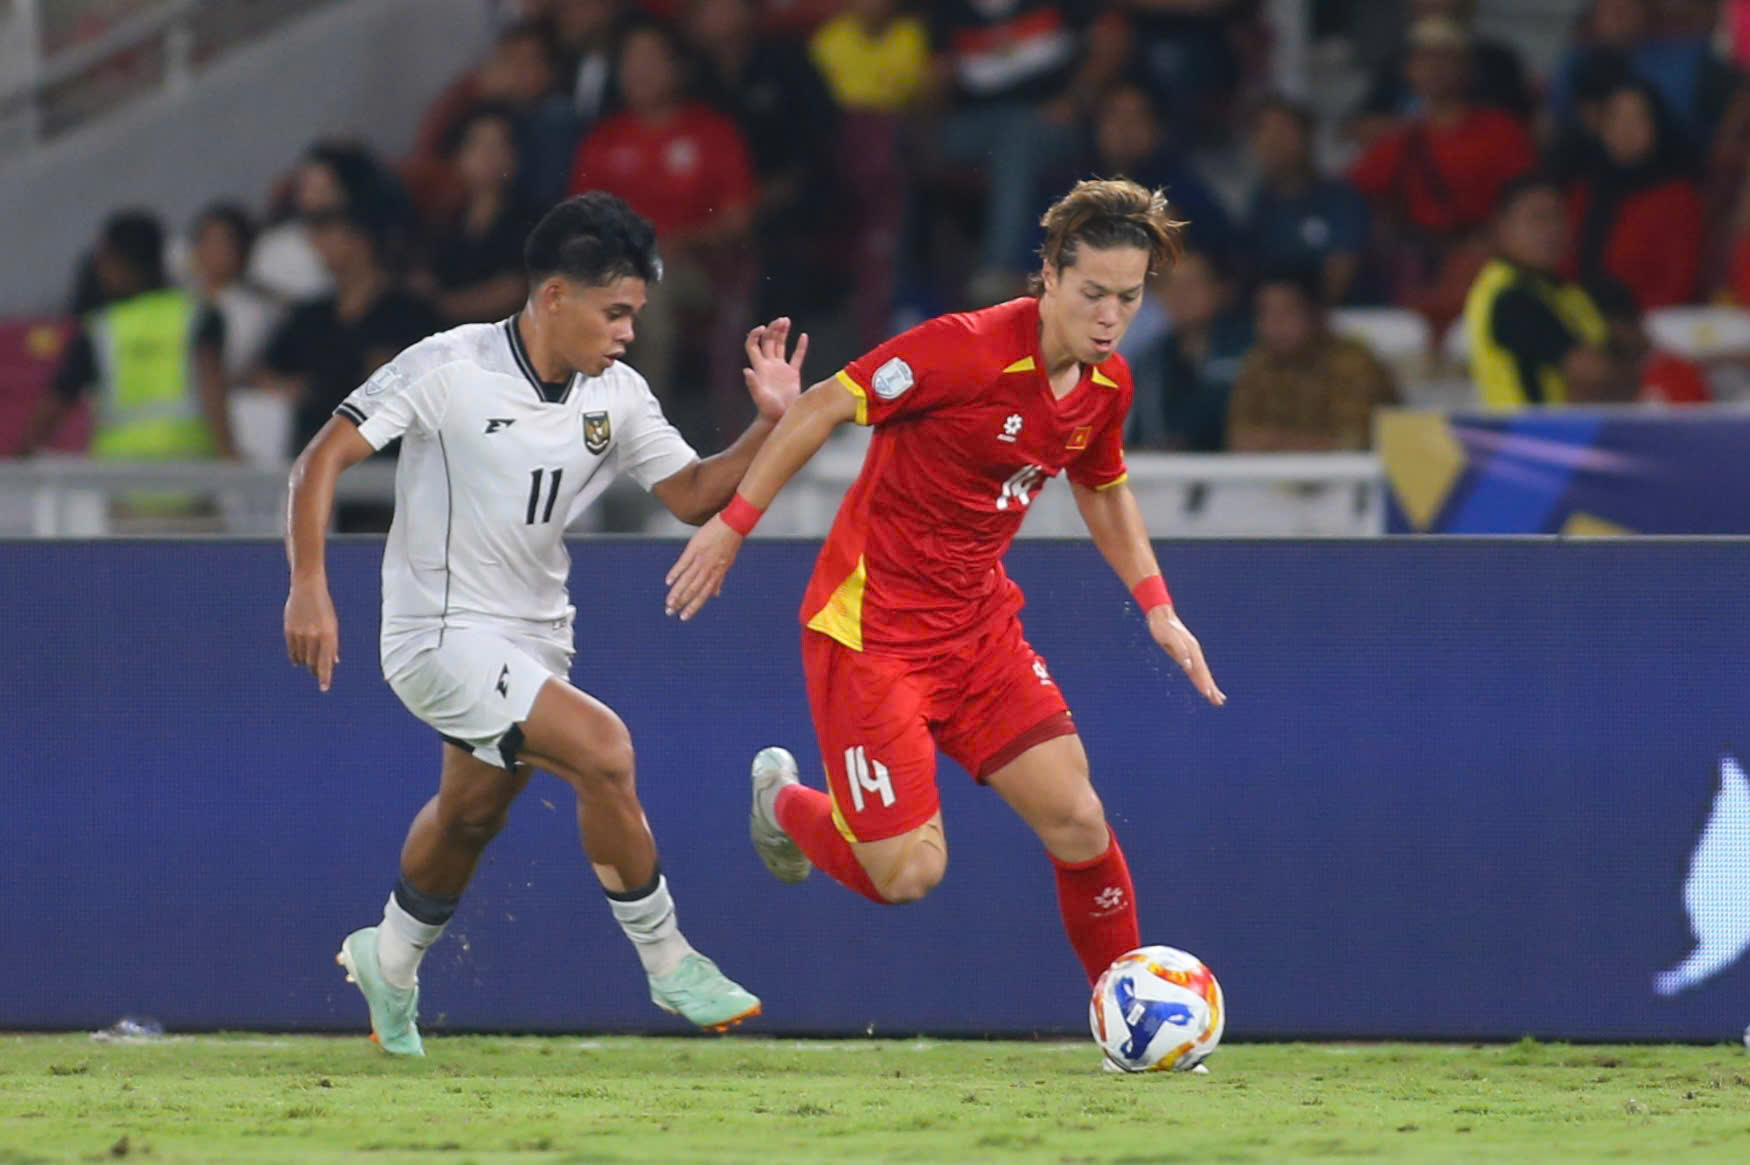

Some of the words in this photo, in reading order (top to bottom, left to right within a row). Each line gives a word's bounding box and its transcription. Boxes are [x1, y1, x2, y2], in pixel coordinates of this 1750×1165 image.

[526, 468, 563, 525] 11
[996, 464, 1043, 510] 14
[844, 745, 896, 812] 14
